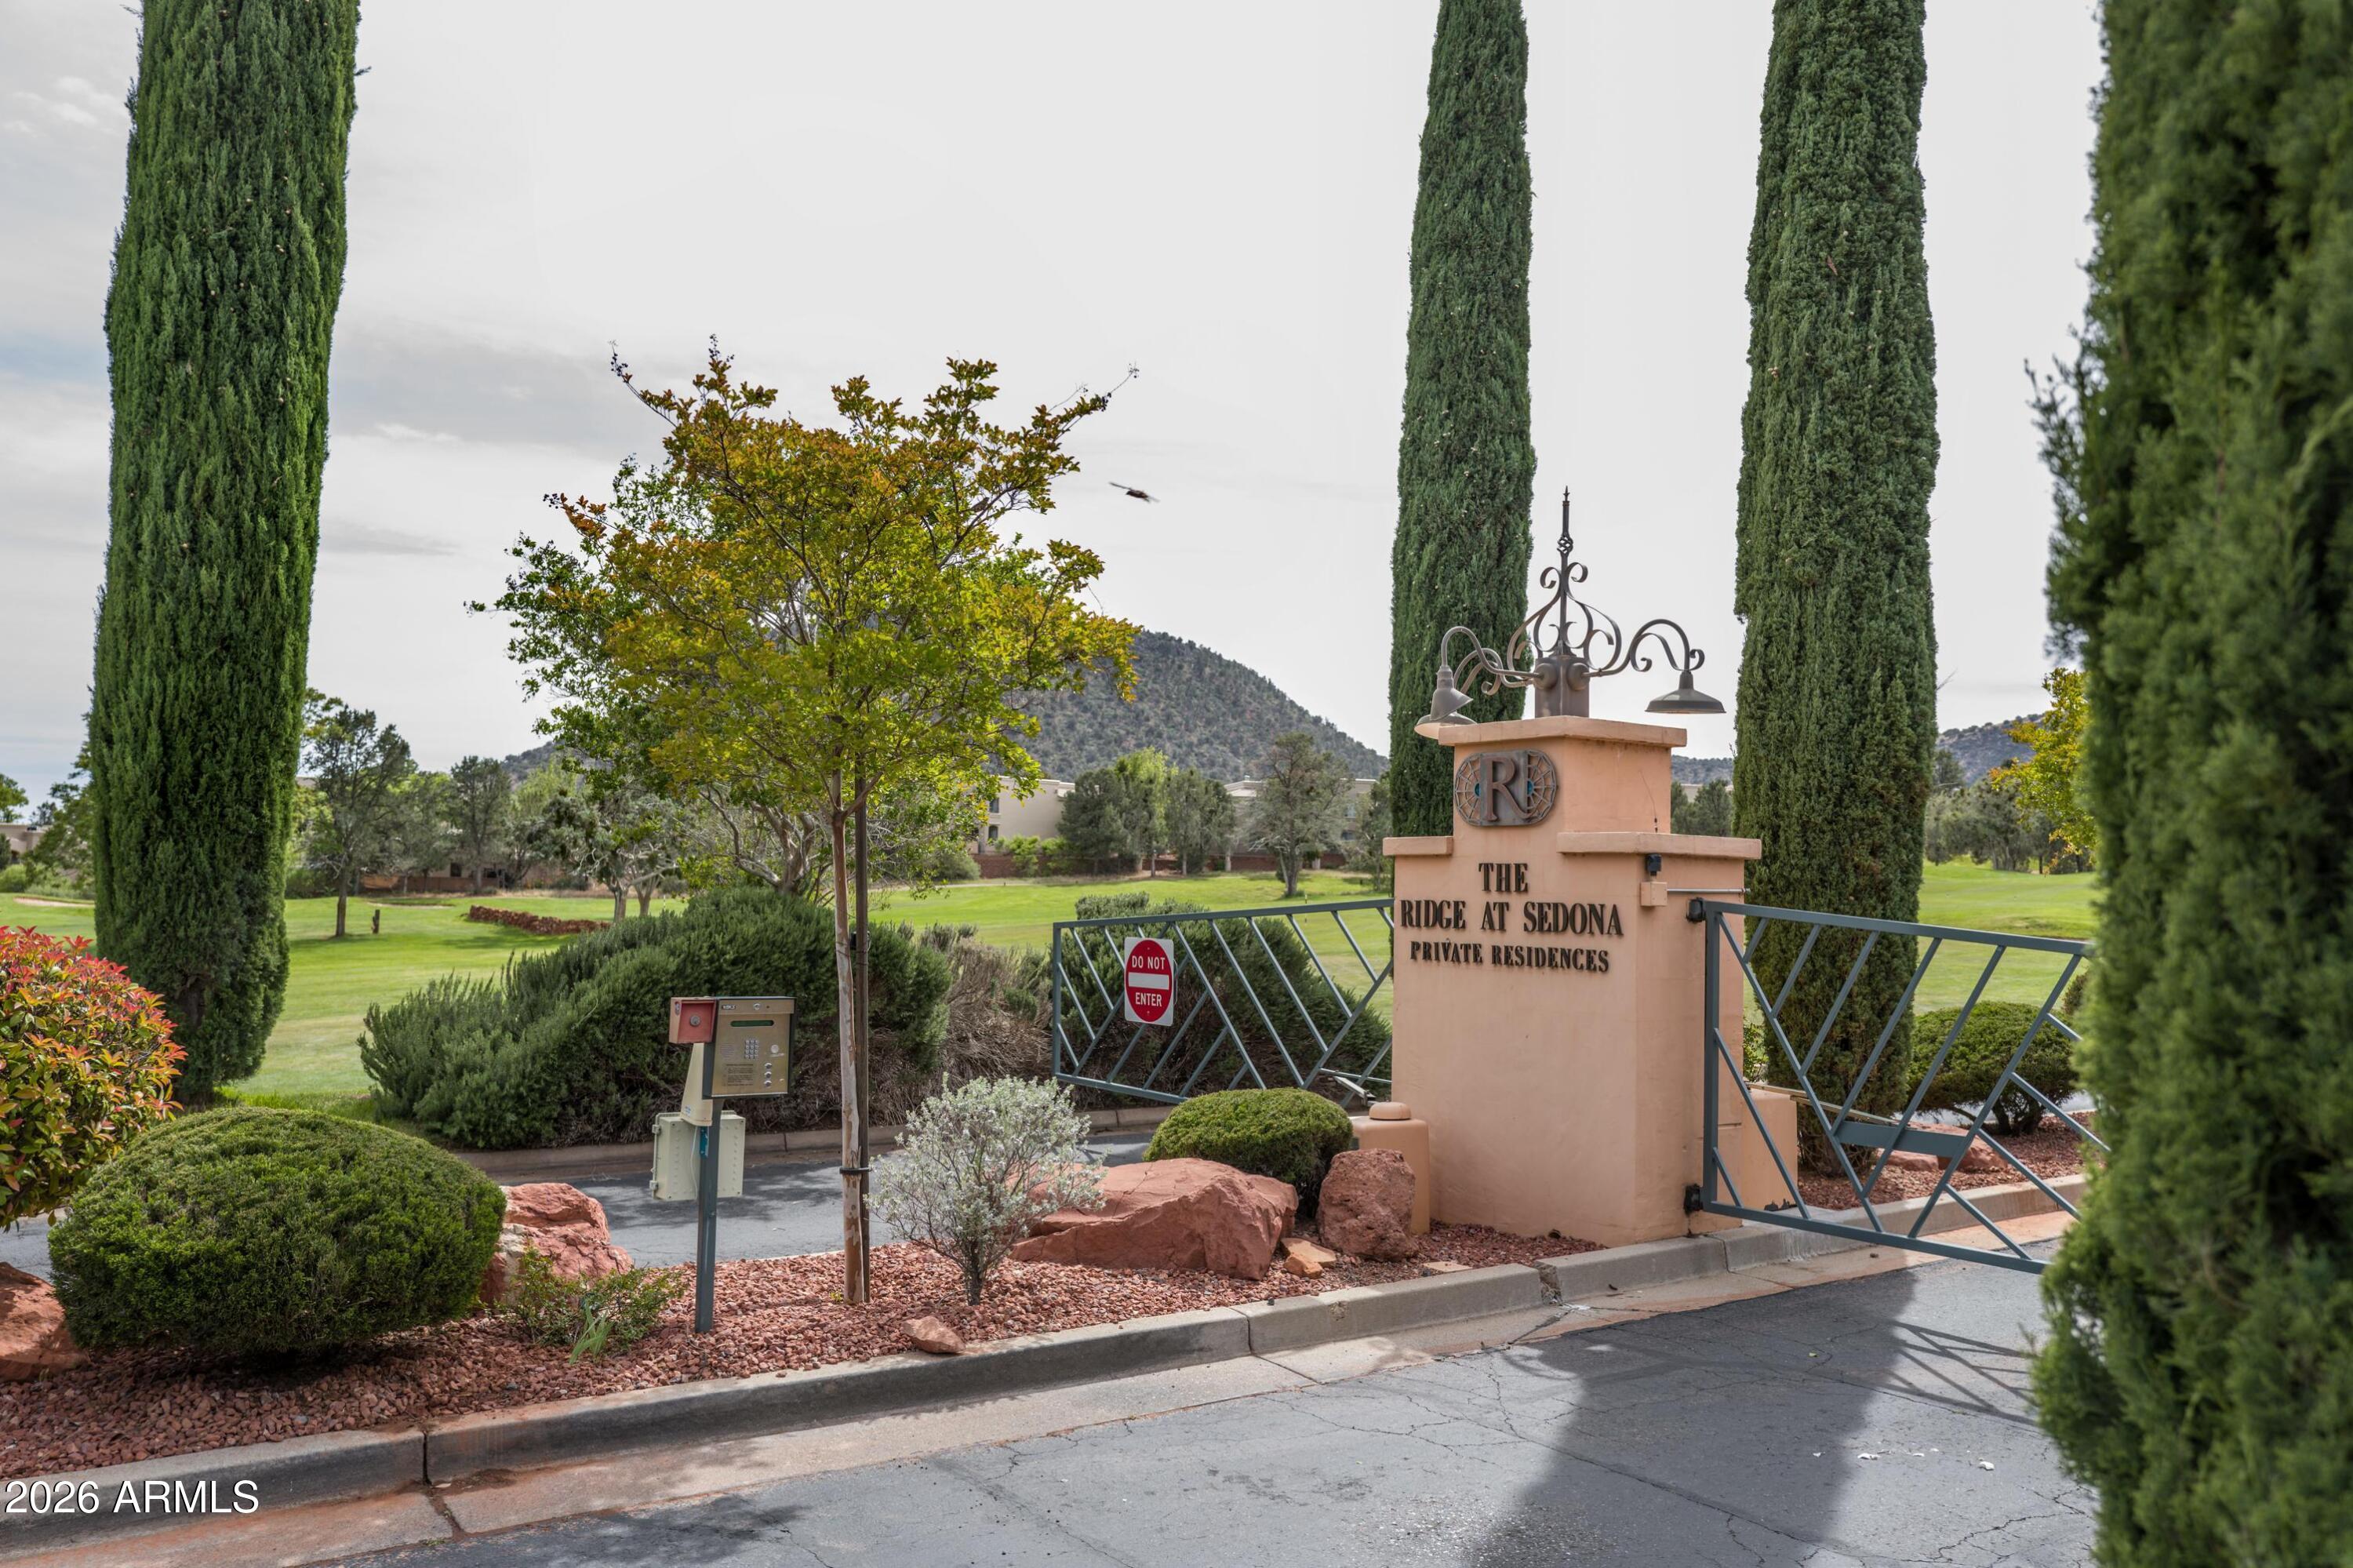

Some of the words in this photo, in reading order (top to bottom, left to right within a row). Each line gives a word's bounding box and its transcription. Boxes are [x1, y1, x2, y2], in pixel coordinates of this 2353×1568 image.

[1478, 863, 1529, 893] THE
[1400, 900, 1466, 930] RIDGE
[1480, 901, 1510, 932] AT
[1523, 901, 1624, 936] SEDONA
[1132, 955, 1144, 968] DO
[1147, 956, 1166, 970] NOT
[1410, 940, 1483, 963] PRIVATE
[1491, 945, 1609, 973] RESIDENCES
[1135, 992, 1162, 1006] ENTER
